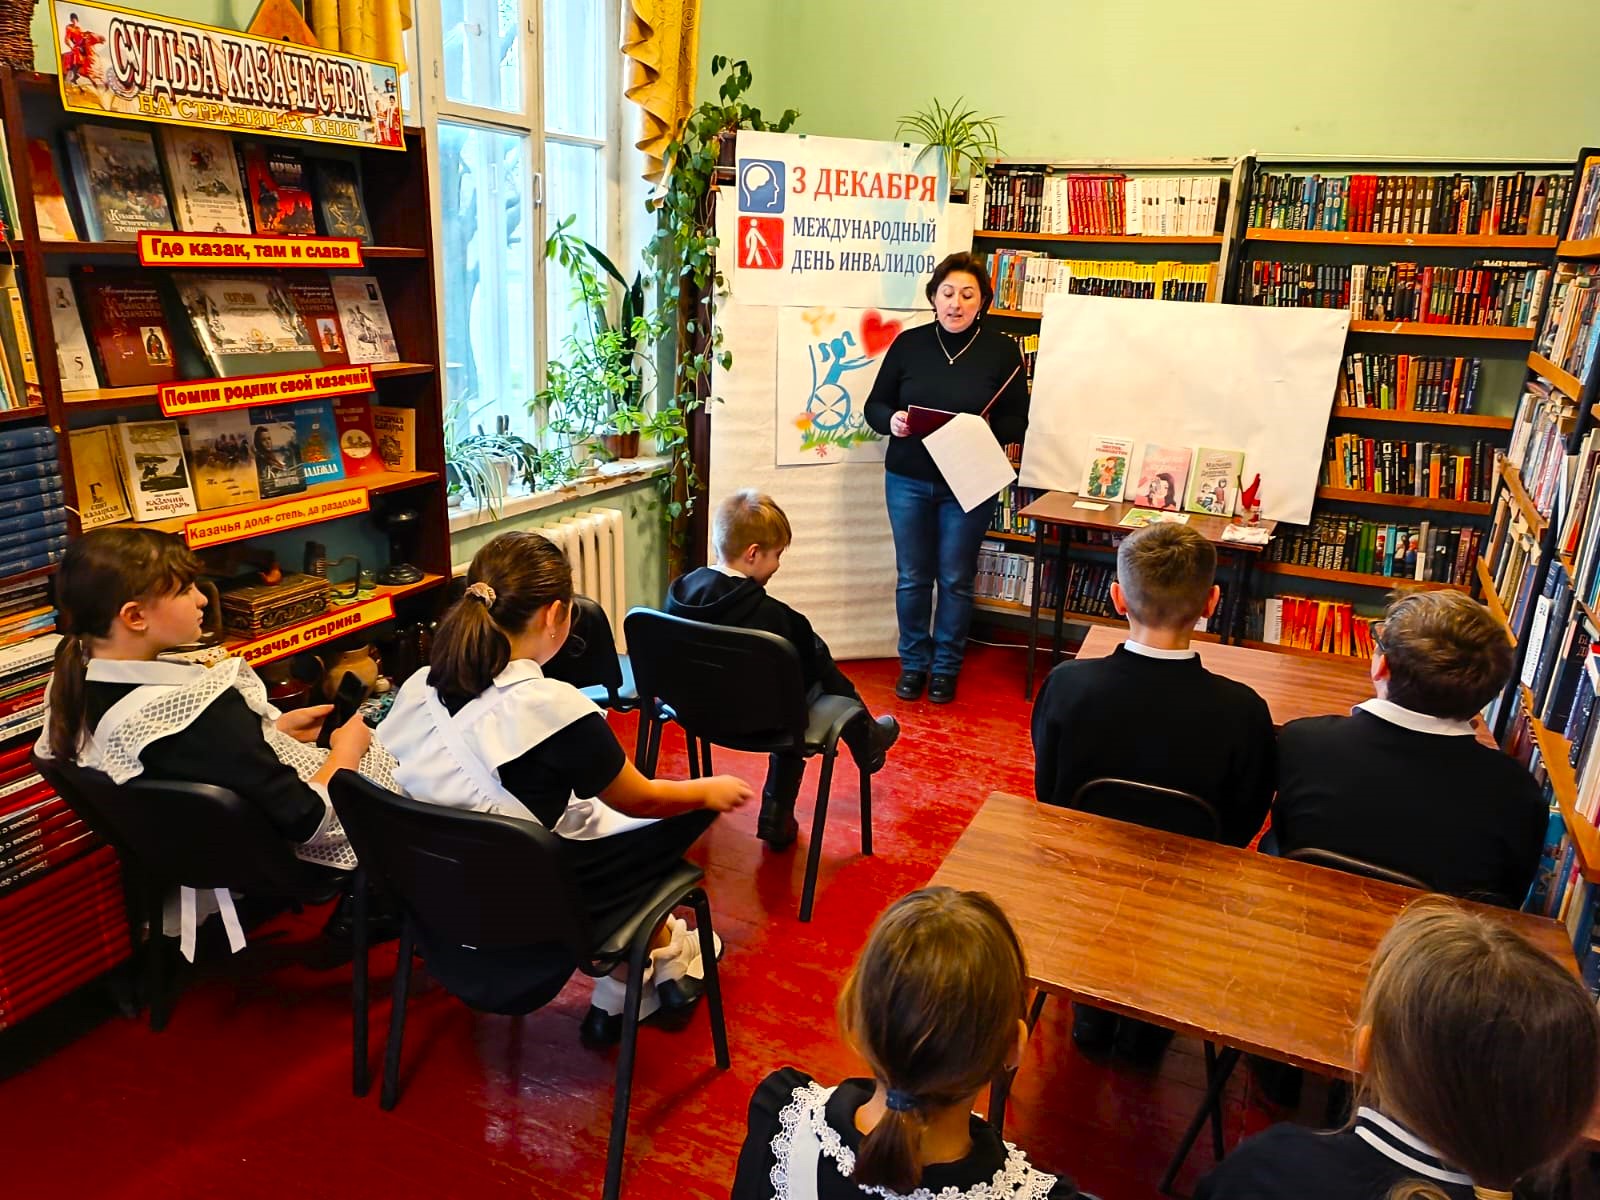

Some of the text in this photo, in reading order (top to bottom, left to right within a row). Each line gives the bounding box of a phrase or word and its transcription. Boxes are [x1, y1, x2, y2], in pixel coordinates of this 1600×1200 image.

[109, 18, 372, 121] СУДЬБА КАЗАЧЕСТВА
[138, 94, 360, 139] НА СТРАНИЦАХ КНИГ
[792, 166, 807, 195] 3
[814, 168, 937, 202] ДЕКАБРЯ
[151, 237, 350, 260] Где казак, там и слава
[793, 216, 937, 244] МЕЖДУНАРОДНЫЙ
[791, 250, 936, 275] ДЕНЬ ИНВАЛИДОВ
[164, 367, 369, 408] Помни родник свой казачий
[190, 520, 241, 541] Казачья
[308, 506, 320, 518] да
[321, 496, 363, 516] раздолье
[229, 611, 362, 665] Казачья старина
